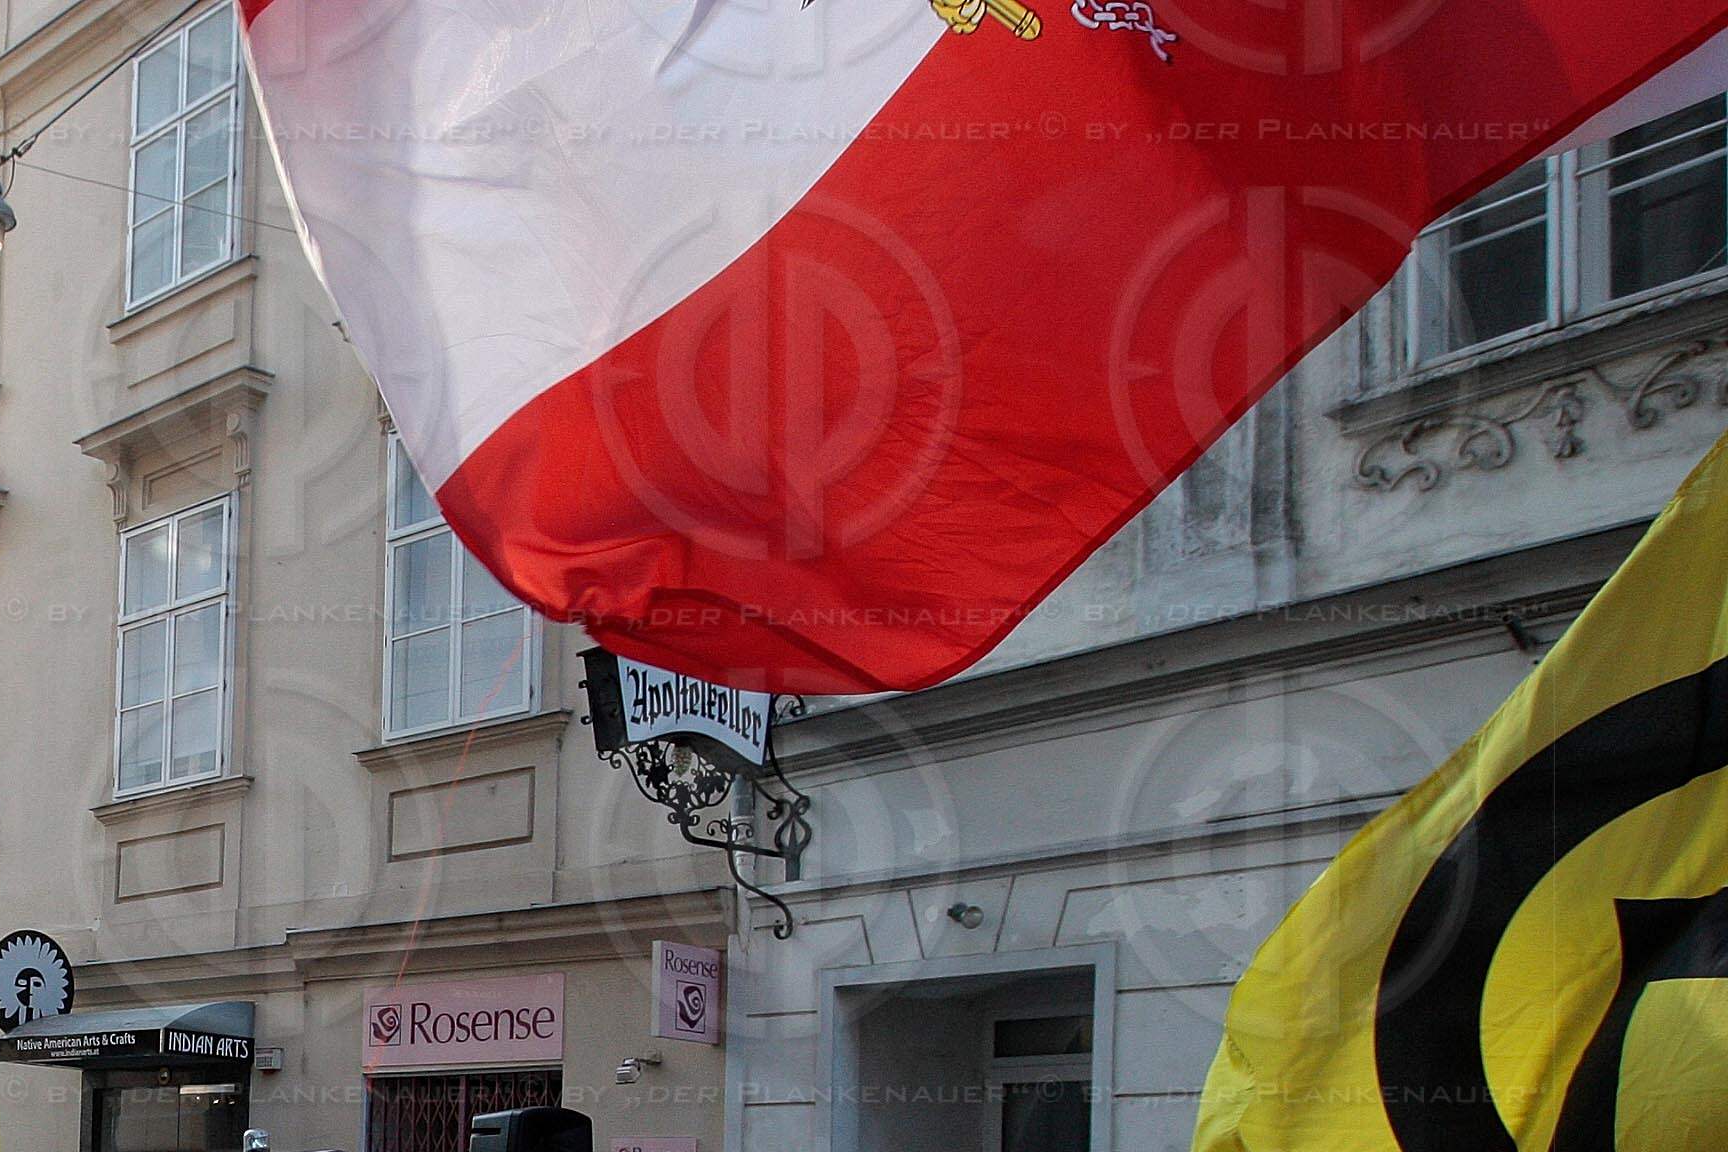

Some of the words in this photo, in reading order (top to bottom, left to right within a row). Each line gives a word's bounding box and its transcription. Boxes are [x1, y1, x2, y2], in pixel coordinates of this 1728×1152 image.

[664, 948, 718, 980] Rosense
[410, 1001, 556, 1045] Rosense
[16, 1039, 43, 1051] Native
[43, 1037, 82, 1049] American
[83, 1035, 101, 1047] Arts
[101, 1034, 109, 1046] &
[110, 1032, 136, 1045] Crafts
[168, 1031, 214, 1055] INDIAN
[216, 1038, 249, 1059] ARTS
